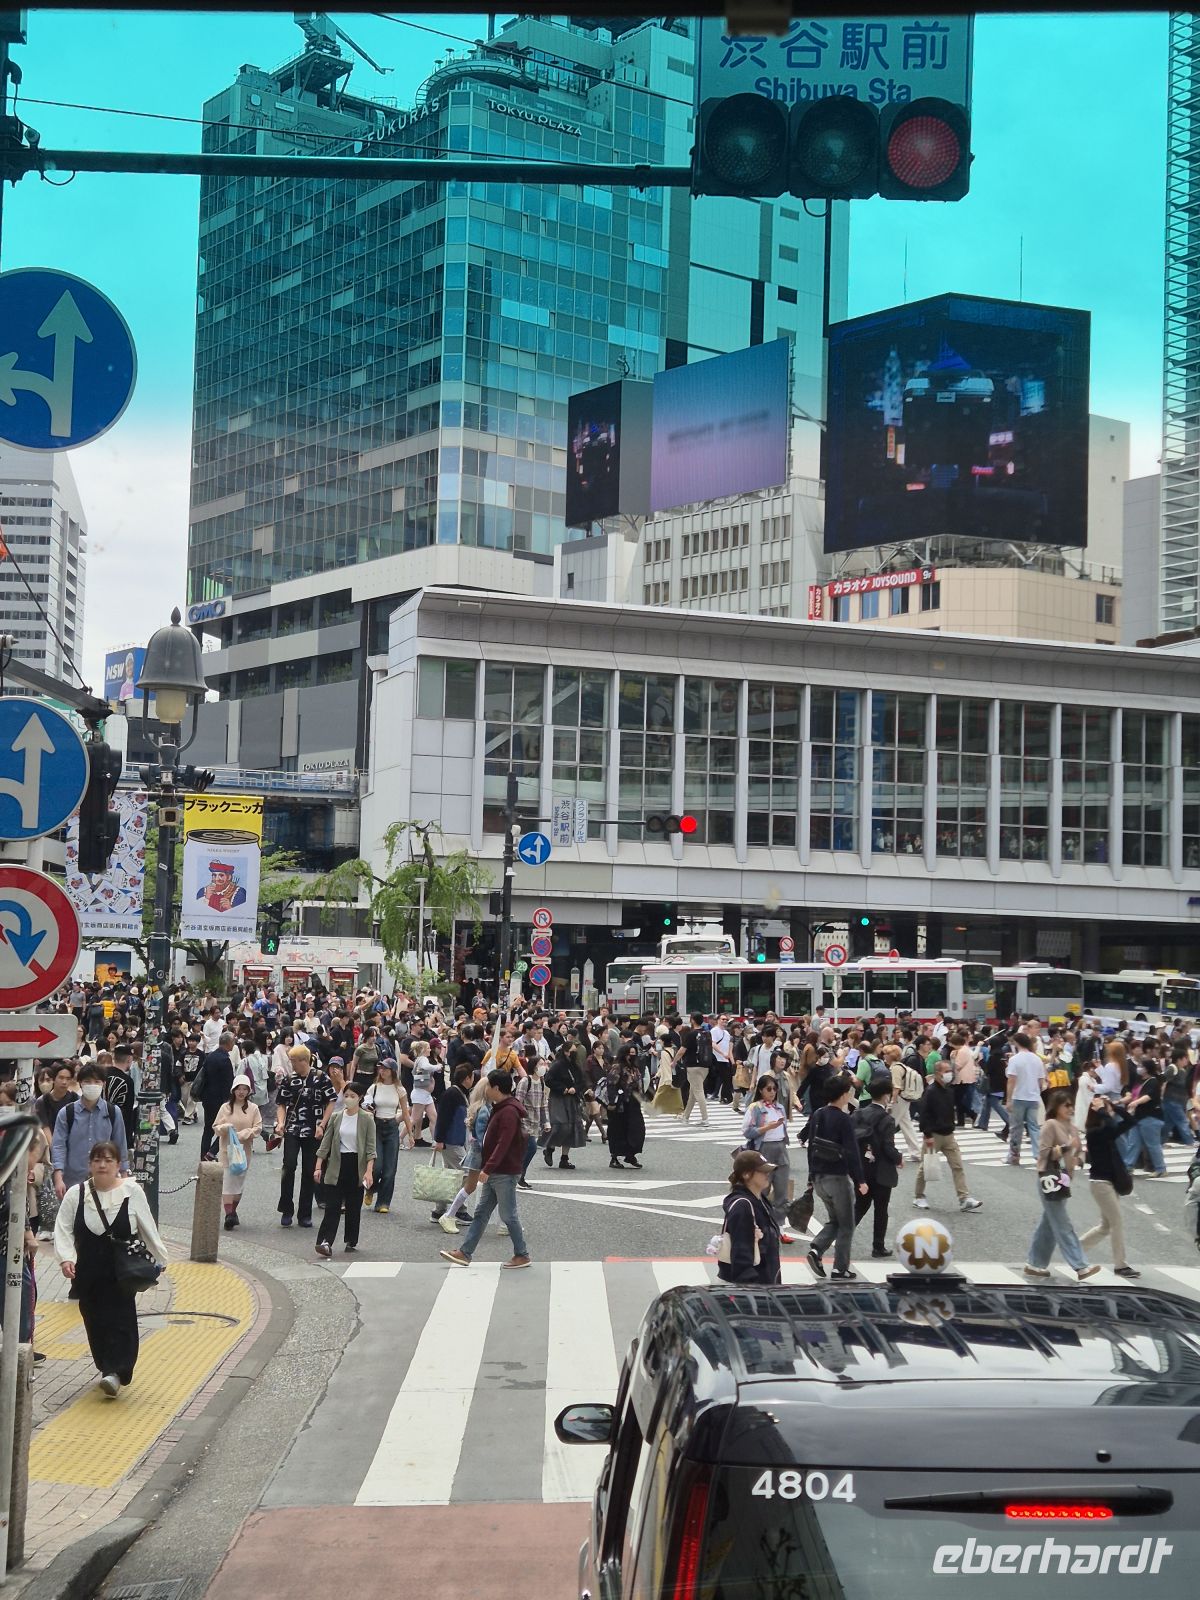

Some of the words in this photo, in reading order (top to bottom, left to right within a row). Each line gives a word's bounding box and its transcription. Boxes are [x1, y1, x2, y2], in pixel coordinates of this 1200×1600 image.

[720, 21, 950, 71] 渋谷駅前
[367, 97, 441, 146] FUKURAS
[488, 99, 535, 121] TOKYU
[537, 114, 583, 137] PLAZA
[834, 579, 870, 594] カラオケ
[872, 571, 917, 588] JOYSOUND
[188, 600, 226, 622] GMO
[302, 762, 324, 771] TOKYU
[325, 759, 350, 769] PLAZA
[184, 799, 264, 815] ブラックニッカ
[126, 826, 144, 835] BLACK
[560, 799, 571, 845] 渋谷駅前
[128, 853, 143, 867] BLACK
[73, 895, 88, 908] BLACK
[109, 891, 121, 907] BLACK
[517, 961, 528, 972] 29
[914, 1235, 939, 1260] N
[751, 1470, 857, 1503] 4804
